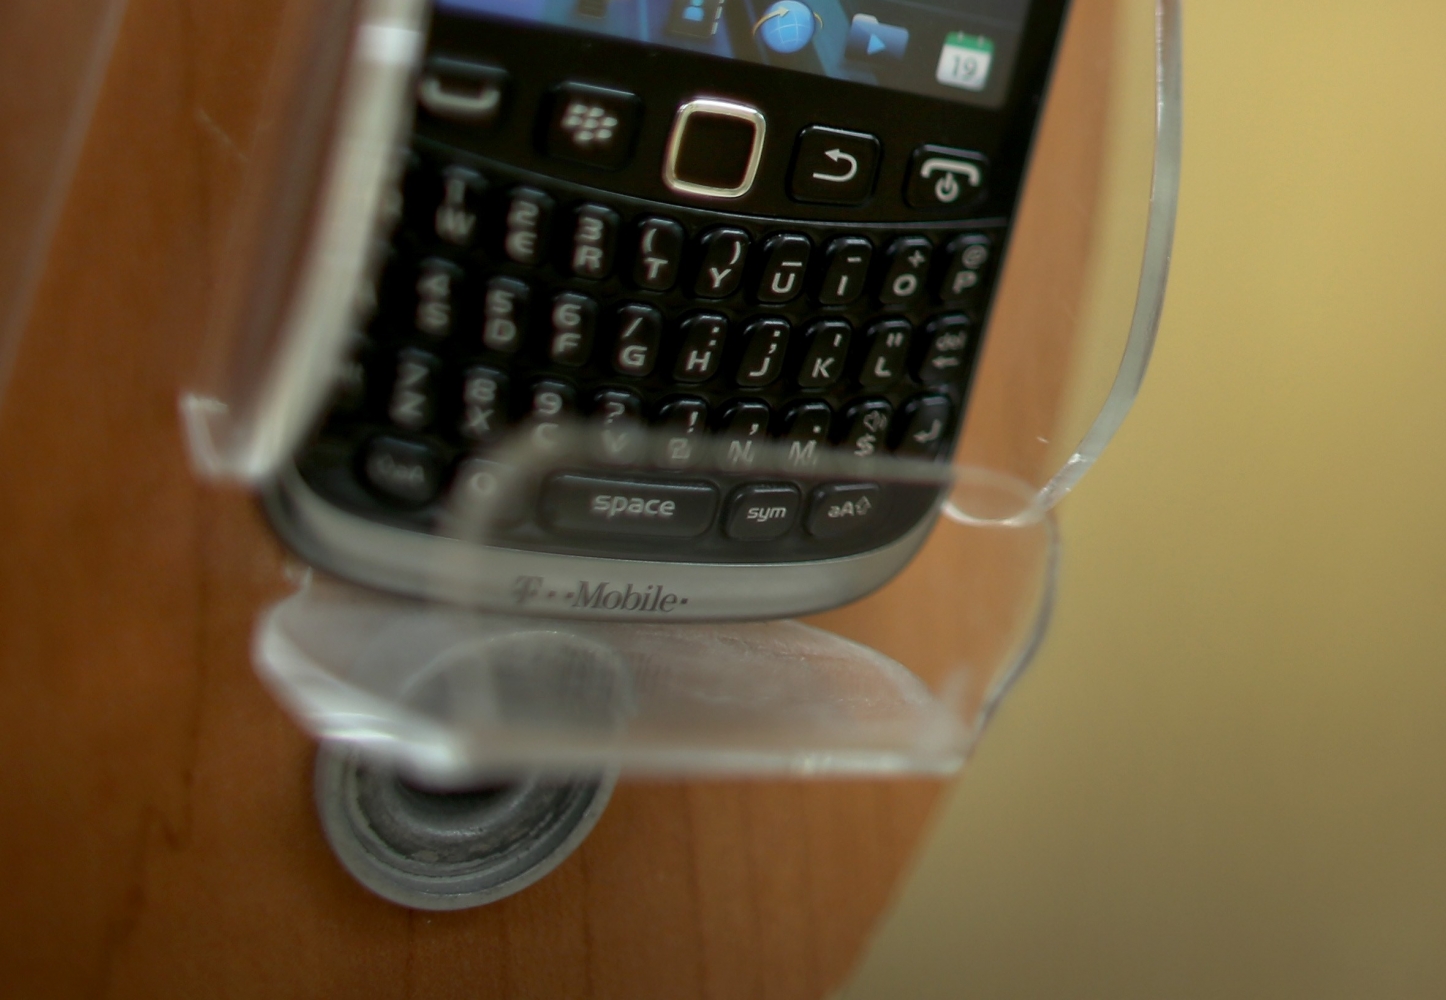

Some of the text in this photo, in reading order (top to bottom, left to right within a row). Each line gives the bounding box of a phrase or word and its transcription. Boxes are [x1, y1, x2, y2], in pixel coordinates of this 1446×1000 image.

[951, 54, 979, 81] 19
[509, 201, 539, 226] 2
[577, 216, 603, 241] 3
[507, 230, 538, 257] E
[574, 245, 603, 270] R
[645, 257, 668, 279] T
[710, 267, 731, 289] Y
[771, 272, 795, 294] U
[893, 273, 917, 296] O
[953, 270, 977, 294] P
[485, 289, 513, 314] 5
[553, 303, 581, 327] 6
[484, 318, 517, 347] D
[553, 332, 581, 354] F
[618, 345, 648, 366] G
[686, 351, 711, 372] H
[749, 357, 770, 377] J
[812, 357, 834, 378] K
[874, 357, 891, 377] L
[469, 378, 498, 402] 8
[536, 392, 562, 414] 9
[466, 406, 494, 433] X
[728, 440, 754, 463] N
[789, 440, 816, 464] M
[593, 494, 676, 518] space
[747, 505, 787, 522] sym
